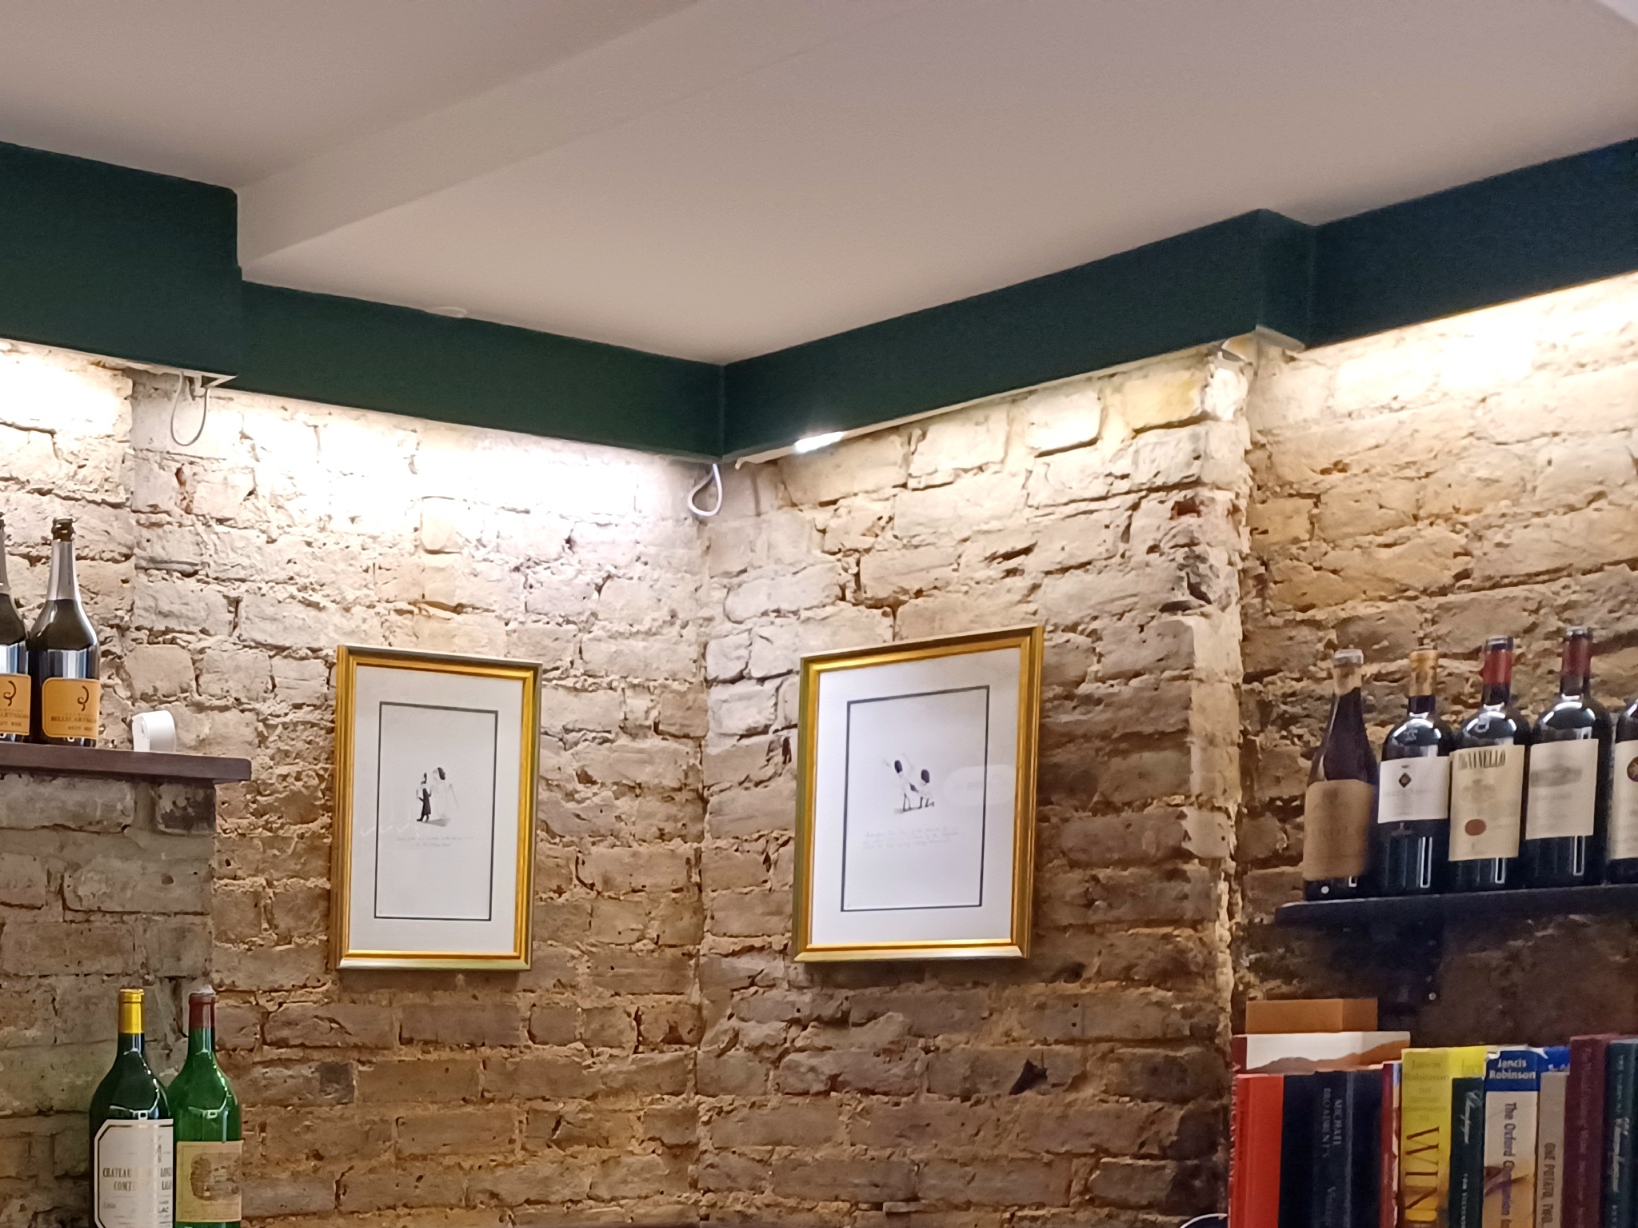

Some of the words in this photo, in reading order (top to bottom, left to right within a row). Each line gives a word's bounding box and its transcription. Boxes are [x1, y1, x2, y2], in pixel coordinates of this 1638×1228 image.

[1498, 1058, 1528, 1069] Jancis
[1489, 1068, 1537, 1080] Robinson
[1504, 1102, 1518, 1120] The
[1503, 1122, 1517, 1157] Oxford
